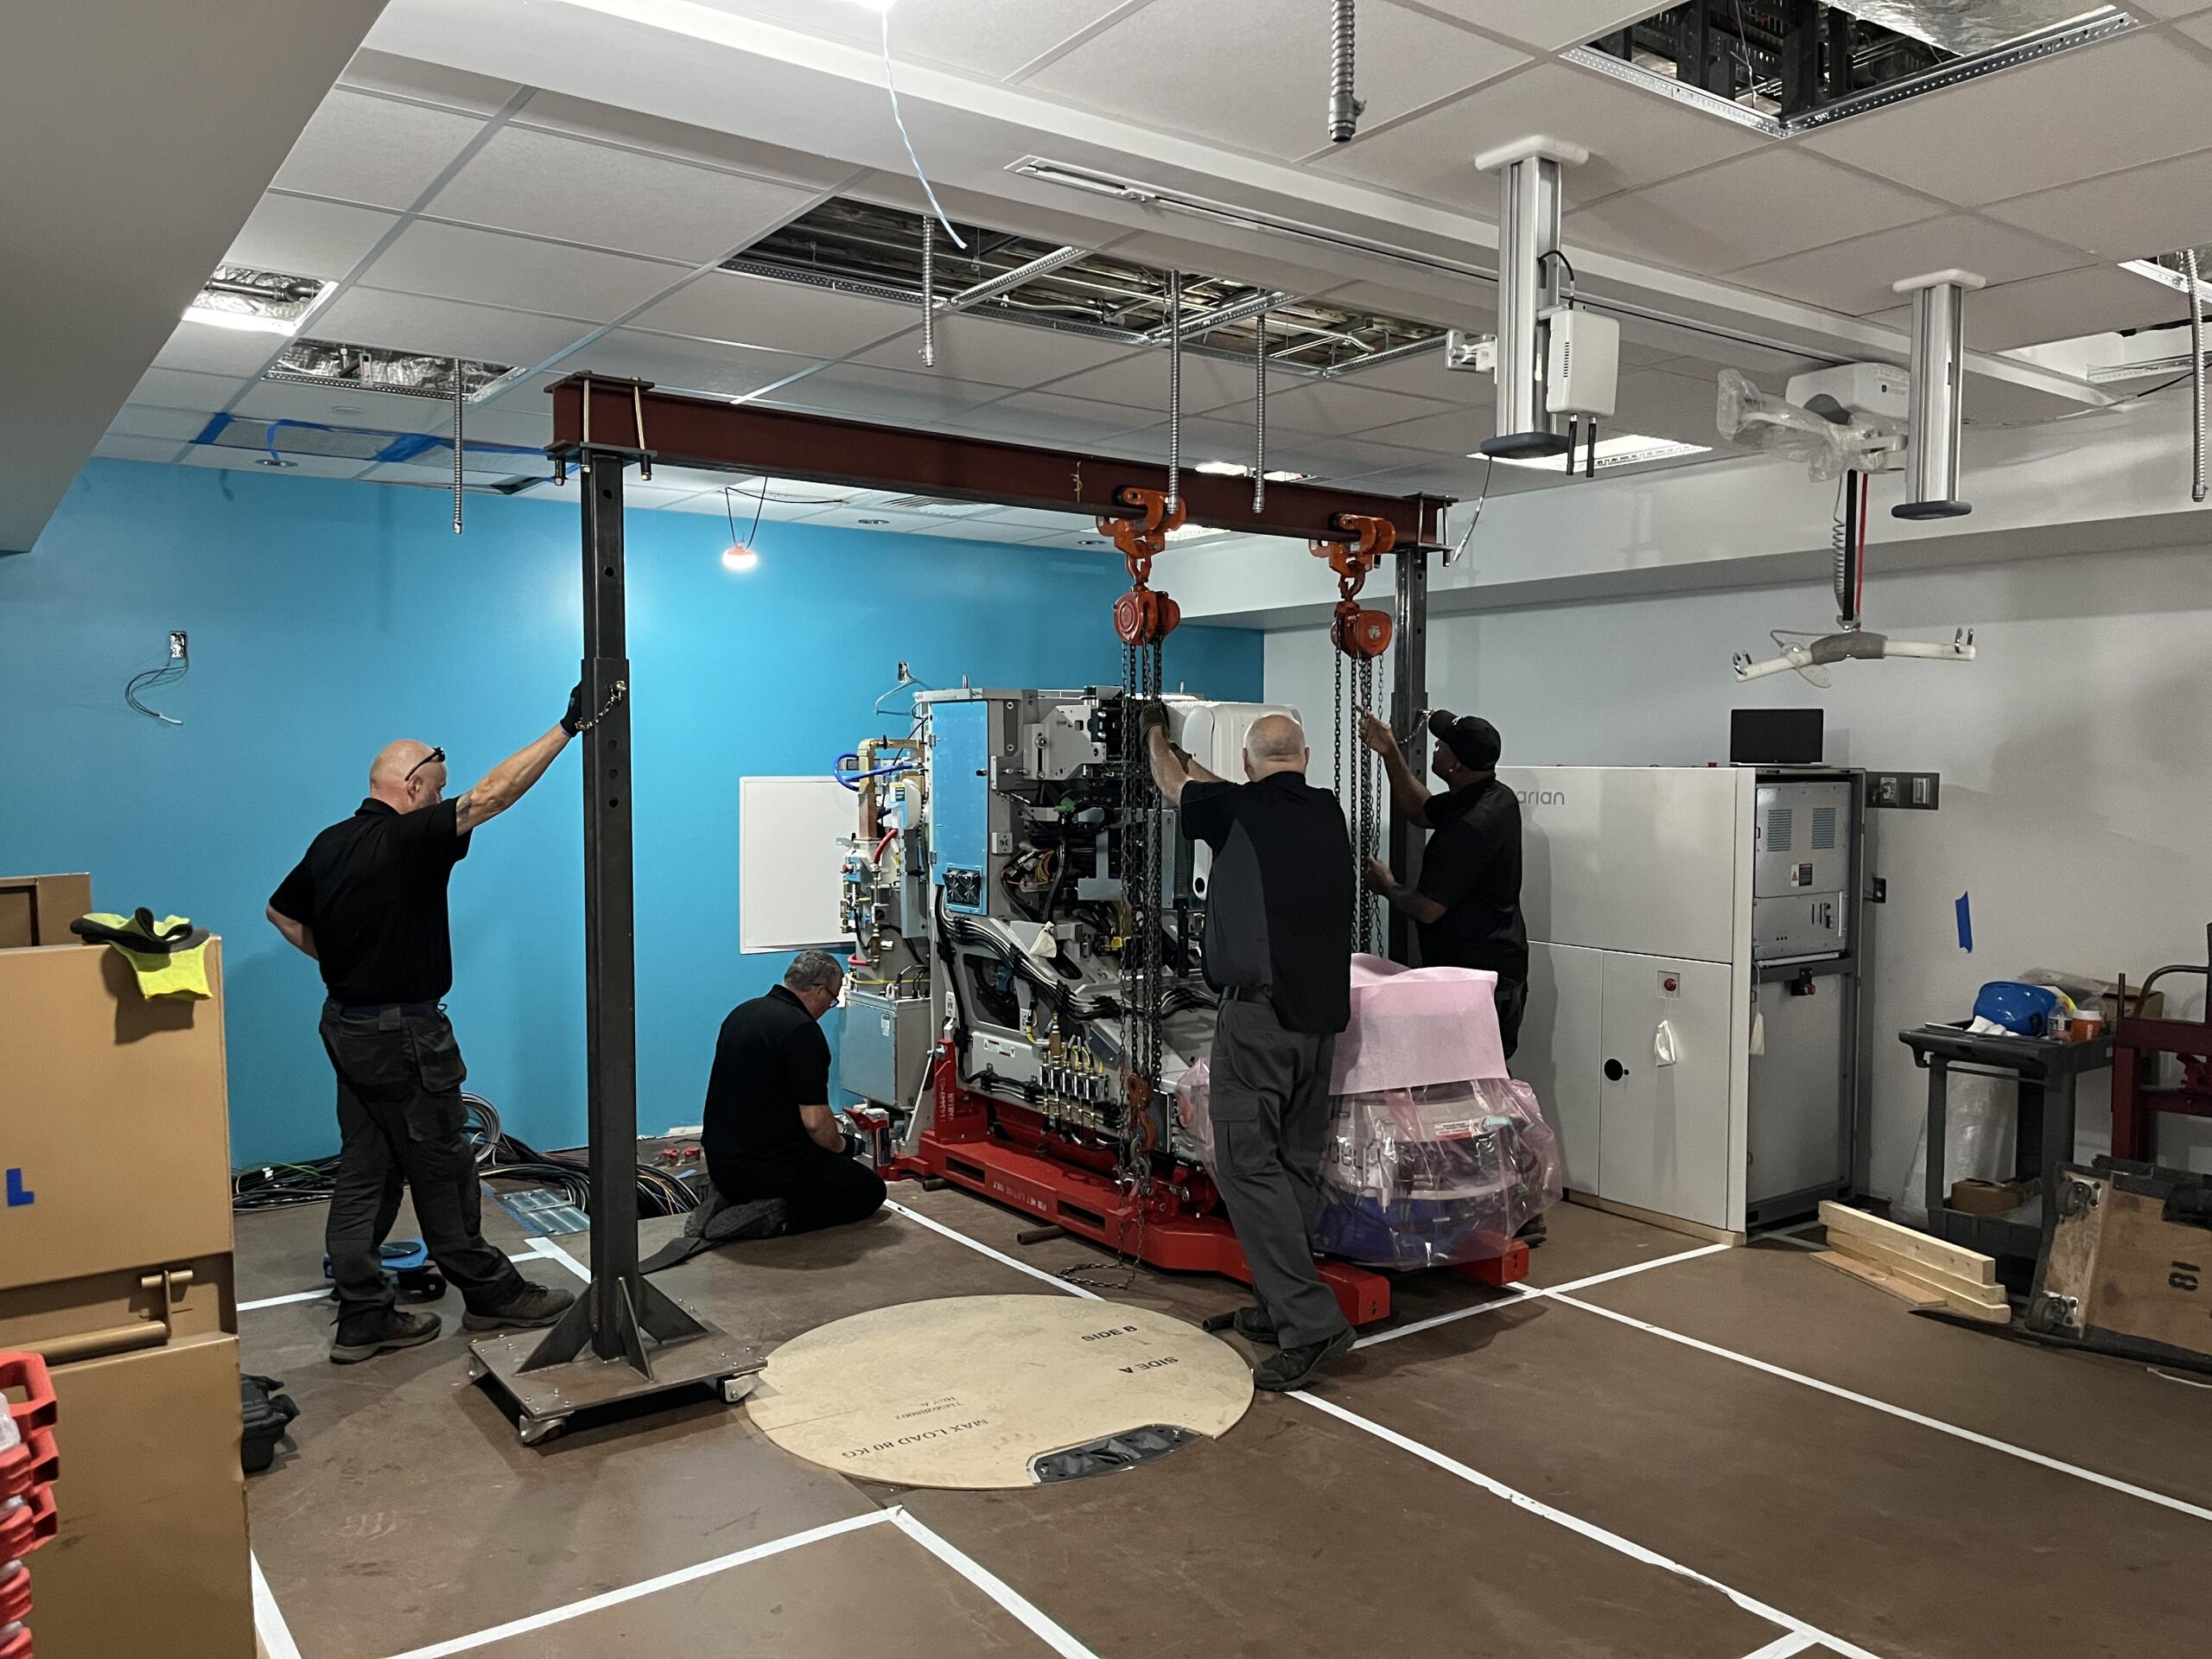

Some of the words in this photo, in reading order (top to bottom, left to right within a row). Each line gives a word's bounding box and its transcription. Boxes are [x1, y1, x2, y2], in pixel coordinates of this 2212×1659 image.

[1516, 790, 1565, 805] arian
[1081, 1328, 1123, 1342] SIDE
[1135, 1357, 1179, 1370] SIDE
[949, 1419, 989, 1433] MAX
[897, 1428, 948, 1446] LOAD
[841, 1446, 871, 1459] KG
